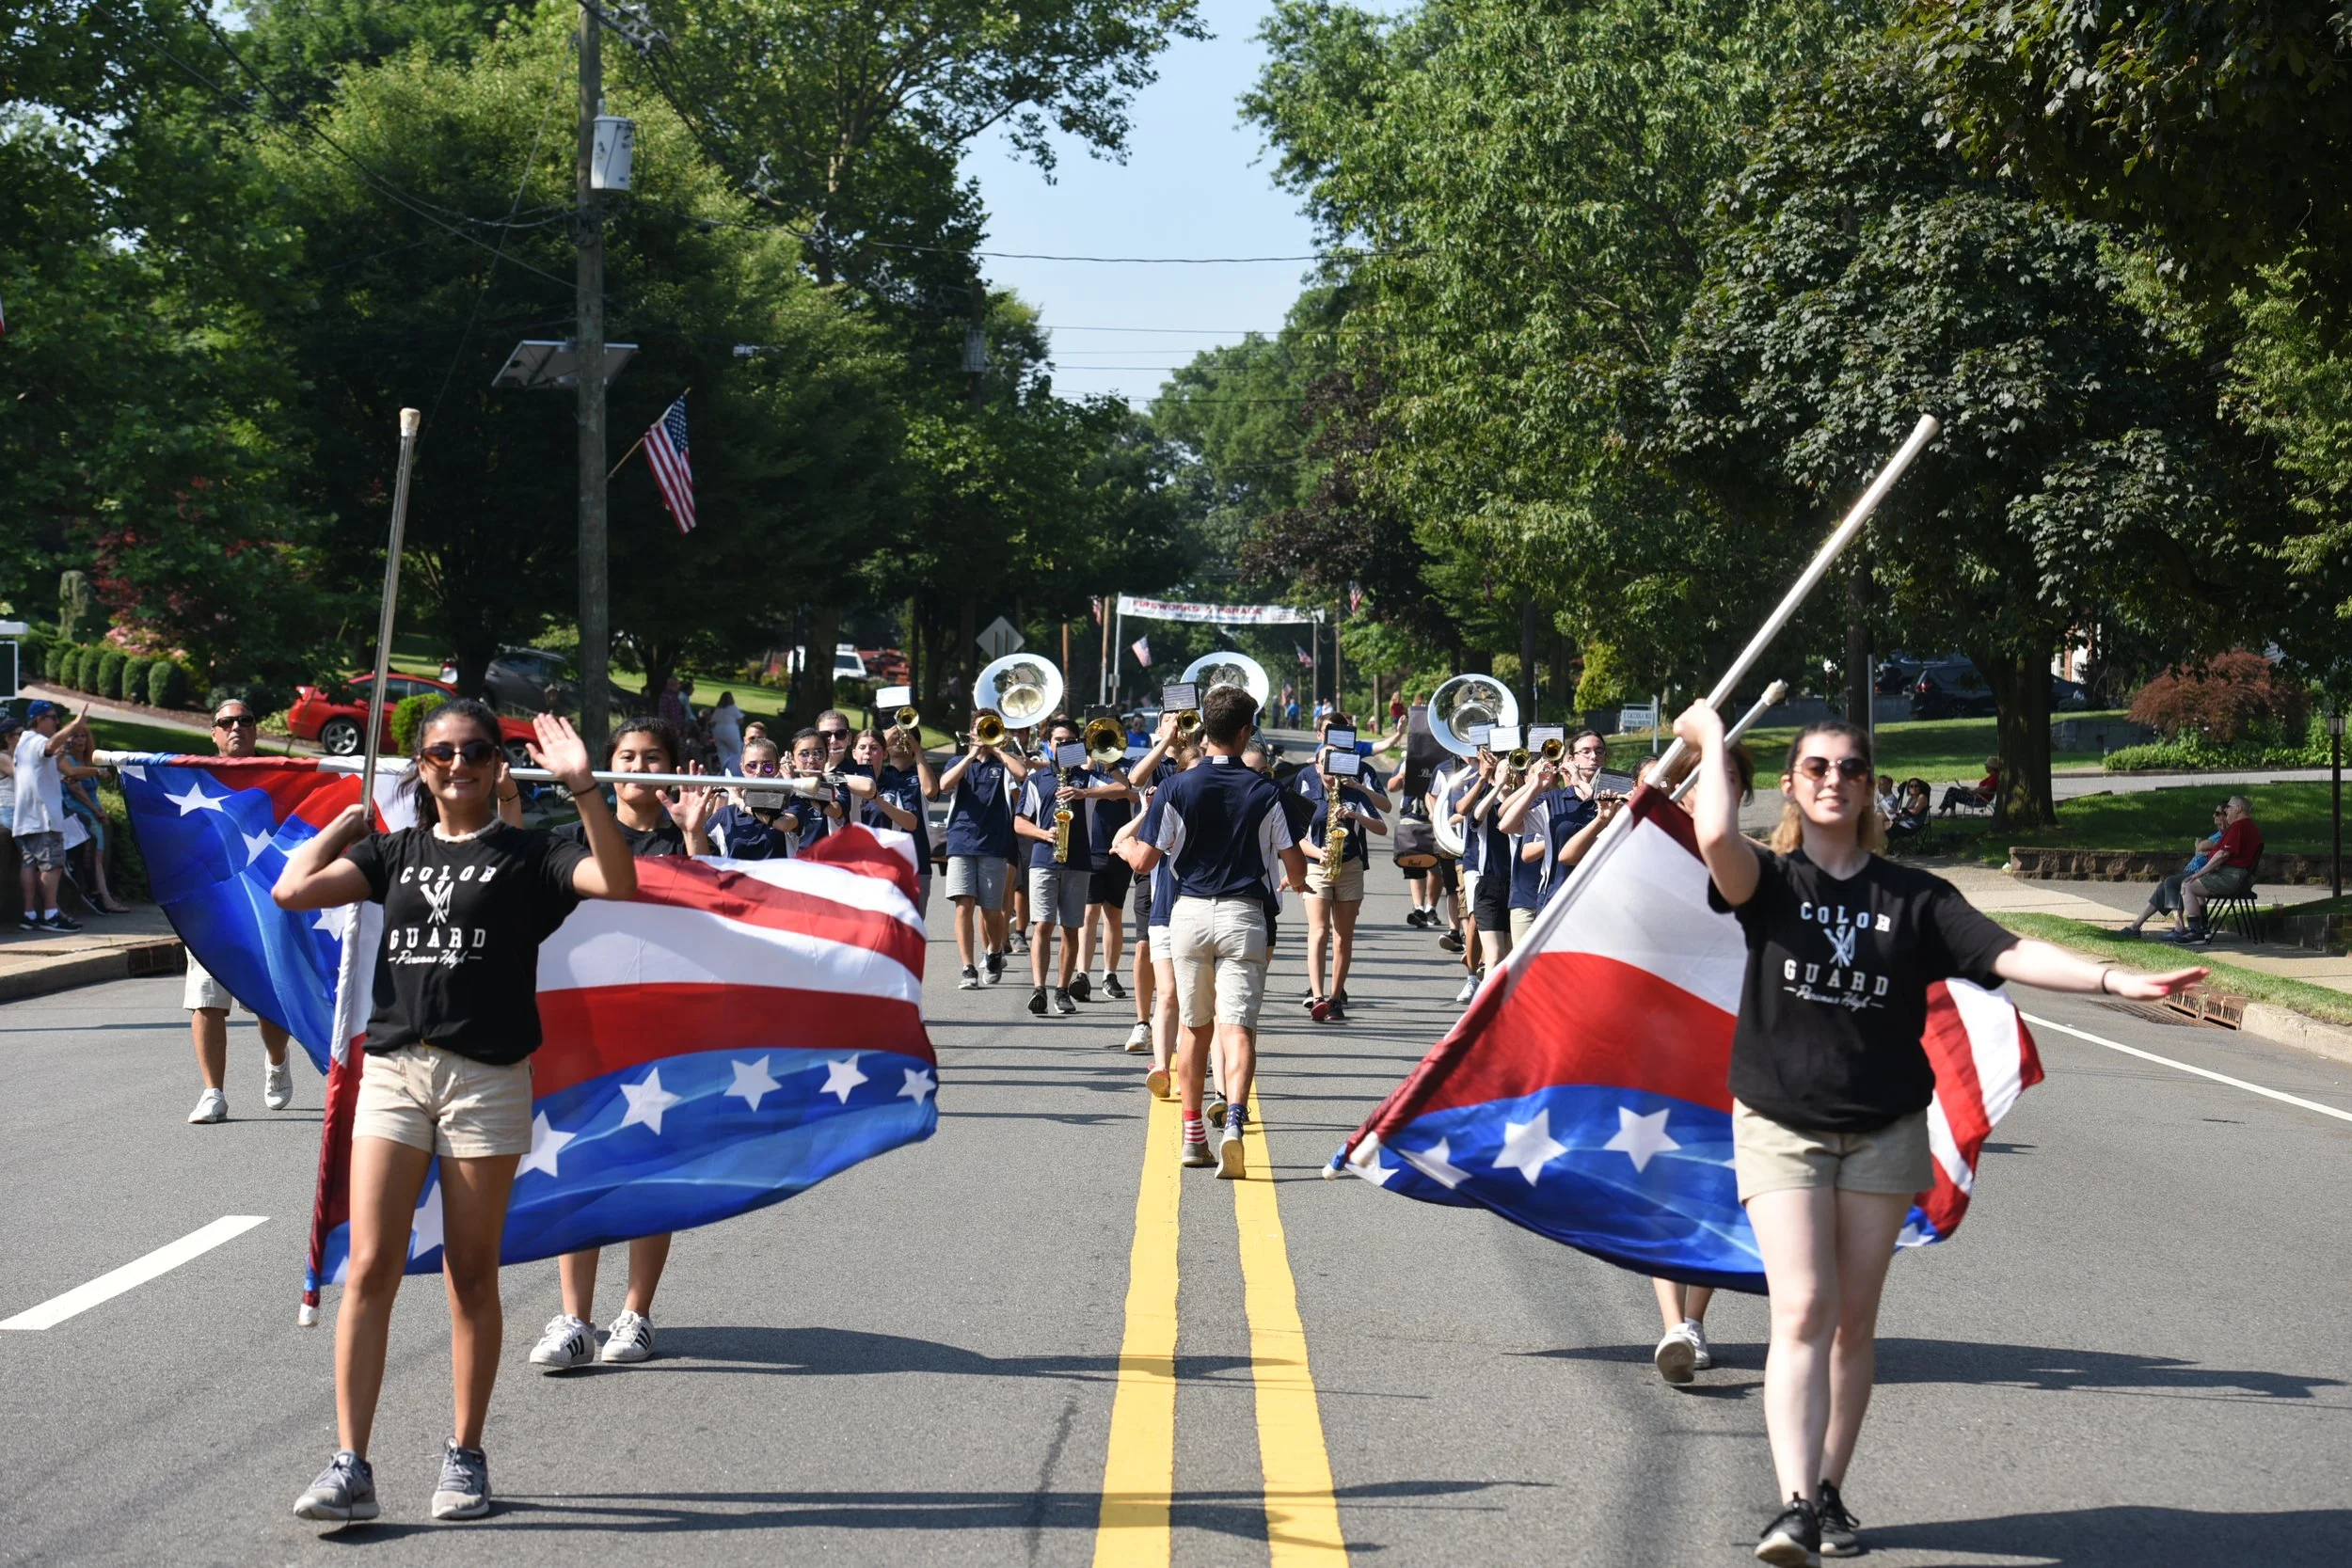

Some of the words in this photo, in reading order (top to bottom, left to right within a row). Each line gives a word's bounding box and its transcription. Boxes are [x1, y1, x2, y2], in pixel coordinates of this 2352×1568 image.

[400, 865, 497, 883] COLOR
[1800, 901, 1891, 932] COLOR
[389, 927, 486, 950] GUARD
[1784, 958, 1889, 996] GUARD
